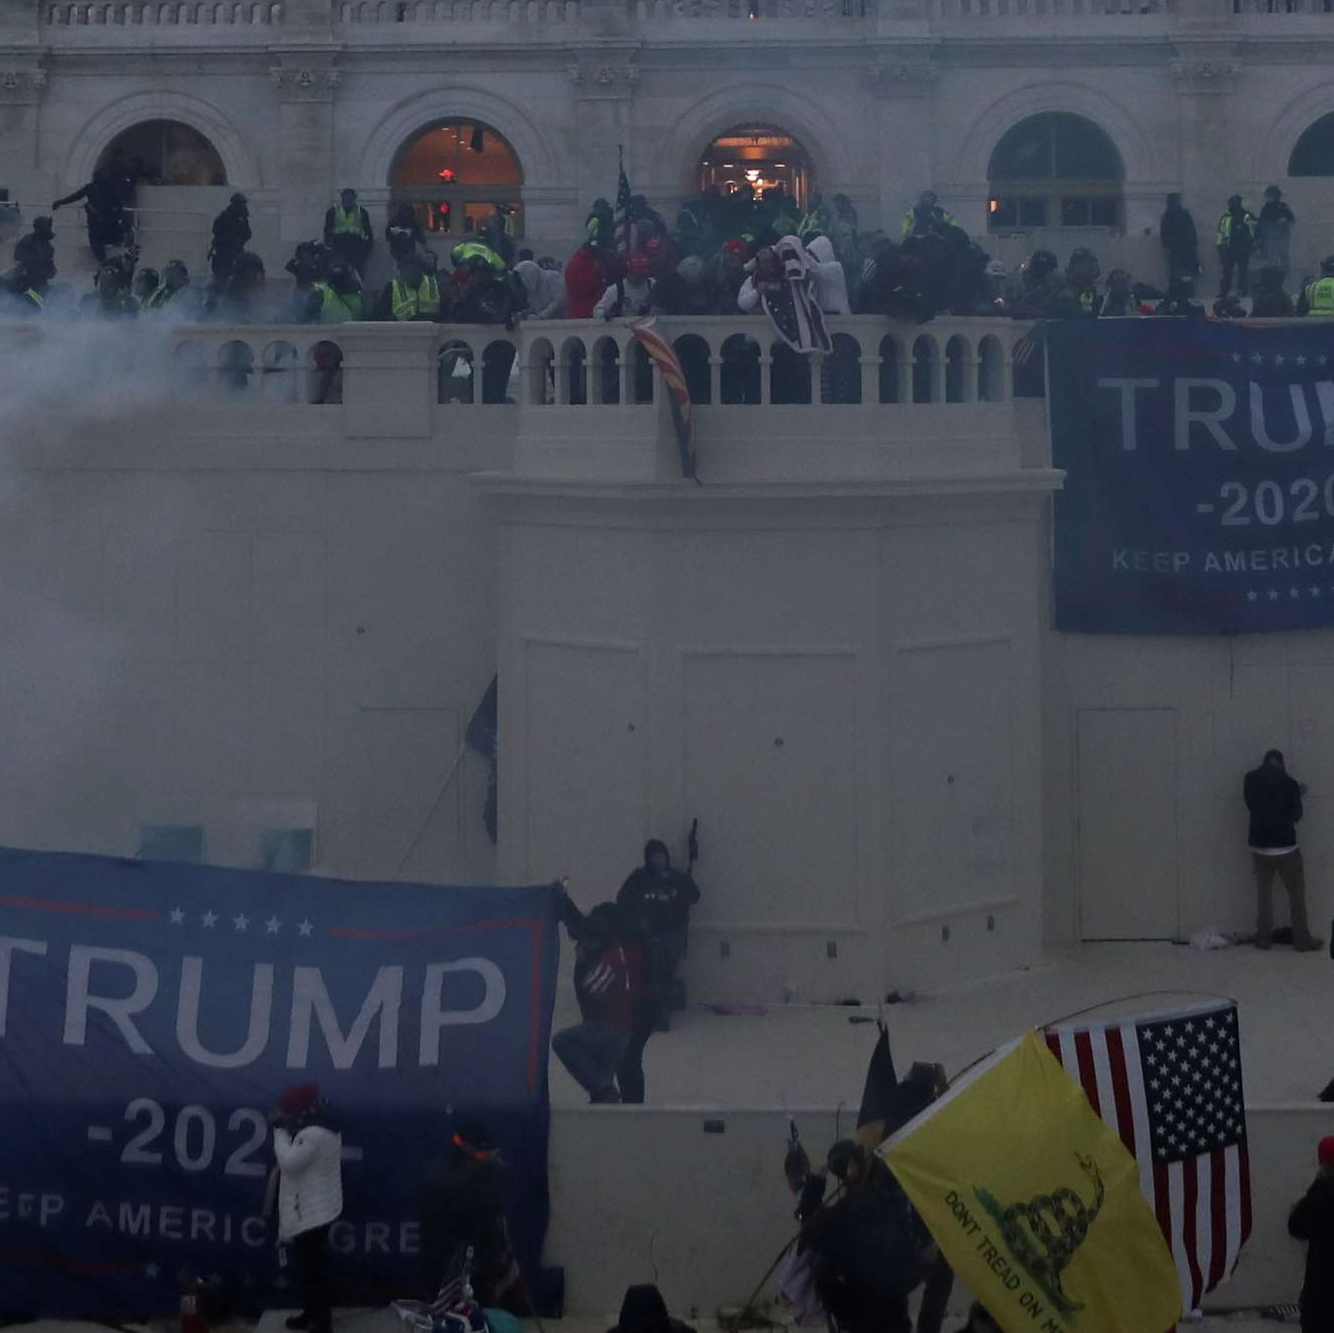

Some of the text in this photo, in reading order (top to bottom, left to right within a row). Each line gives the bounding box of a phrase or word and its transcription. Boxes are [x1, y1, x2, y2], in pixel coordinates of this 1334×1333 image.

[1113, 549, 1190, 572] KEEP
[87, 1097, 365, 1177] -202-
[85, 1200, 268, 1247] AMERIC
[327, 1220, 420, 1254] GRE
[945, 1190, 981, 1236] DONT
[977, 1236, 1020, 1290] TREAD
[1019, 1291, 1043, 1319] ON
